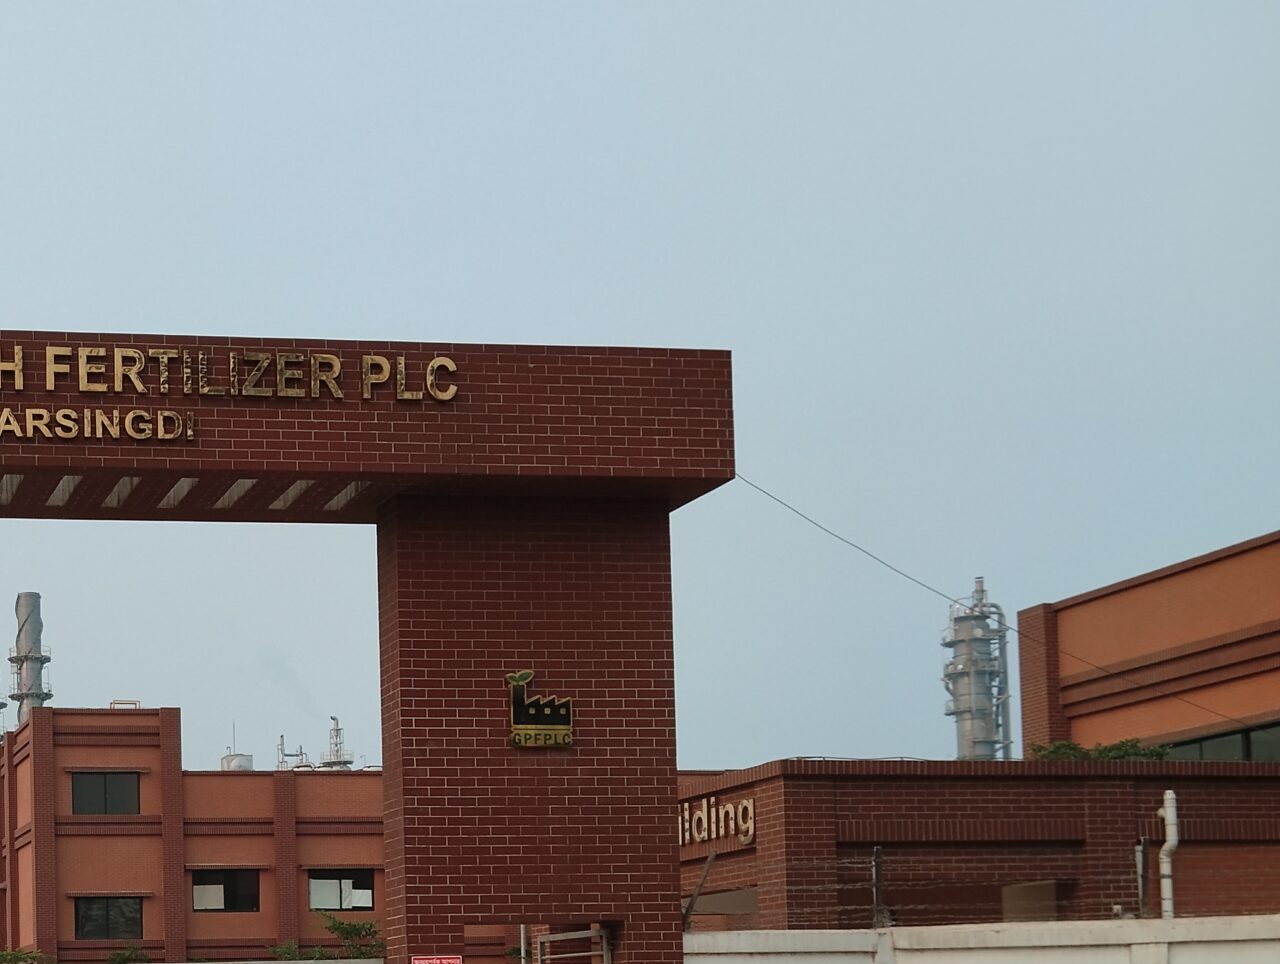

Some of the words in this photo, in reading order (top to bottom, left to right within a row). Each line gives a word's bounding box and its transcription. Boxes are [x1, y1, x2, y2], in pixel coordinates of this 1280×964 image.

[45, 346, 344, 398] FERTILIZER
[361, 355, 459, 401] PLC
[512, 732, 572, 746] GPFPLC
